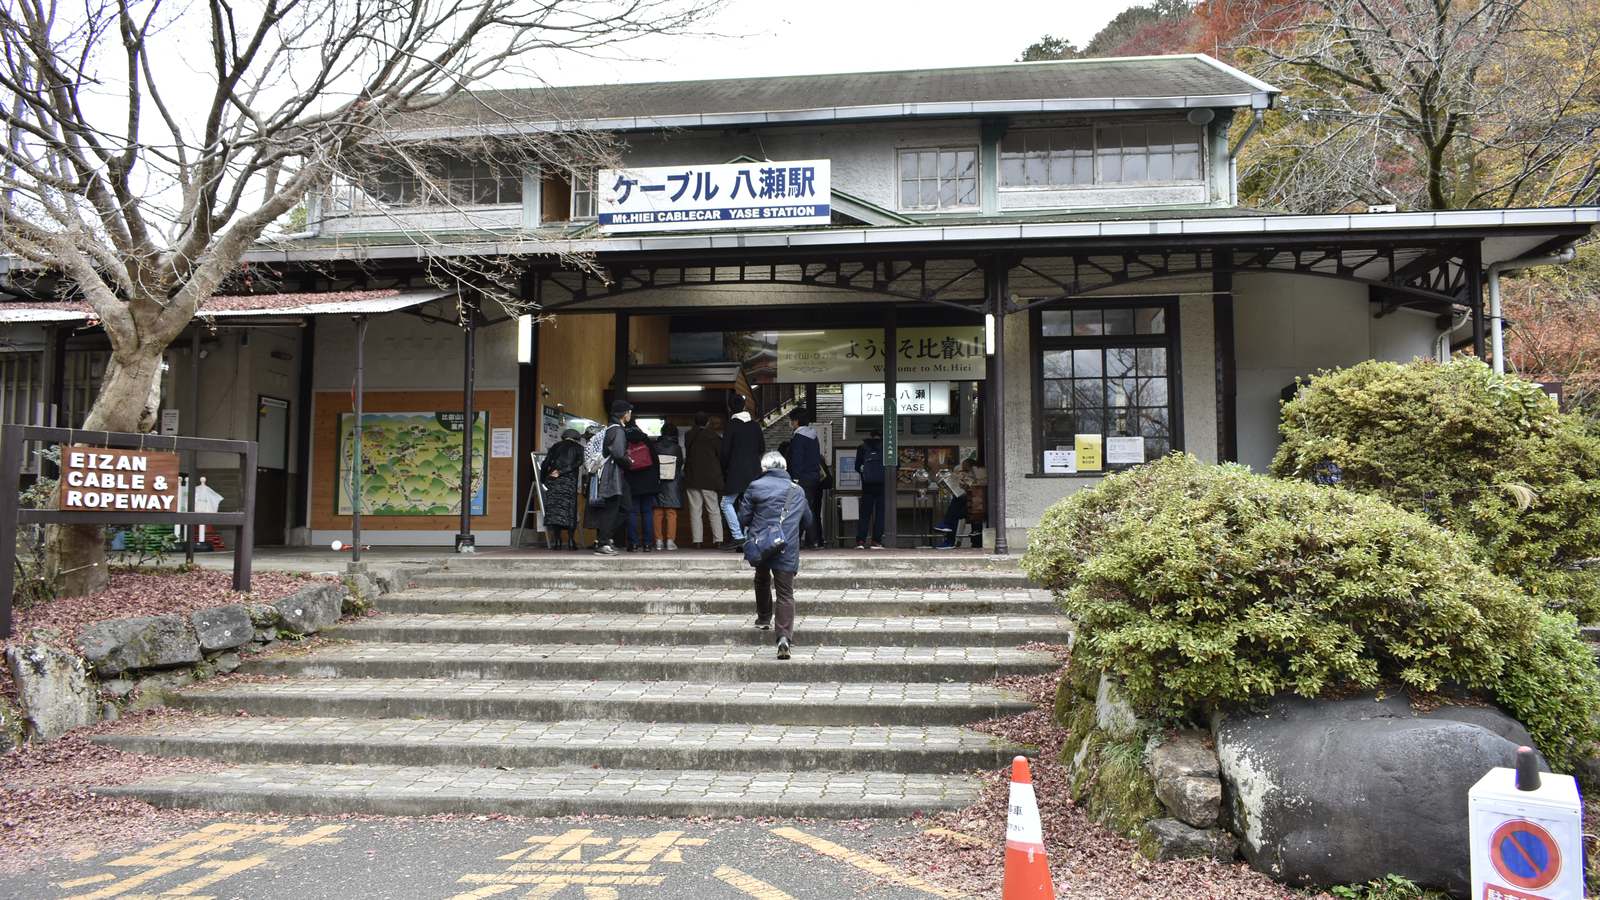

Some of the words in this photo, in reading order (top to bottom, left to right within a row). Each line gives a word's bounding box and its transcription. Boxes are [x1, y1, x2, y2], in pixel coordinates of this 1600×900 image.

[612, 170, 719, 205] ケーブル
[730, 167, 815, 200] 八瀬駅
[612, 213, 654, 224] Mt.HIEI
[658, 210, 721, 222] CABLECAR
[729, 208, 760, 219] YASE
[762, 205, 815, 217] STATION
[873, 364, 918, 373] Wome
[901, 403, 925, 411] YASE
[70, 452, 147, 472] EIZAN
[68, 471, 145, 490] CABLE
[153, 475, 169, 491] &
[66, 490, 175, 510] ROPEWAY
